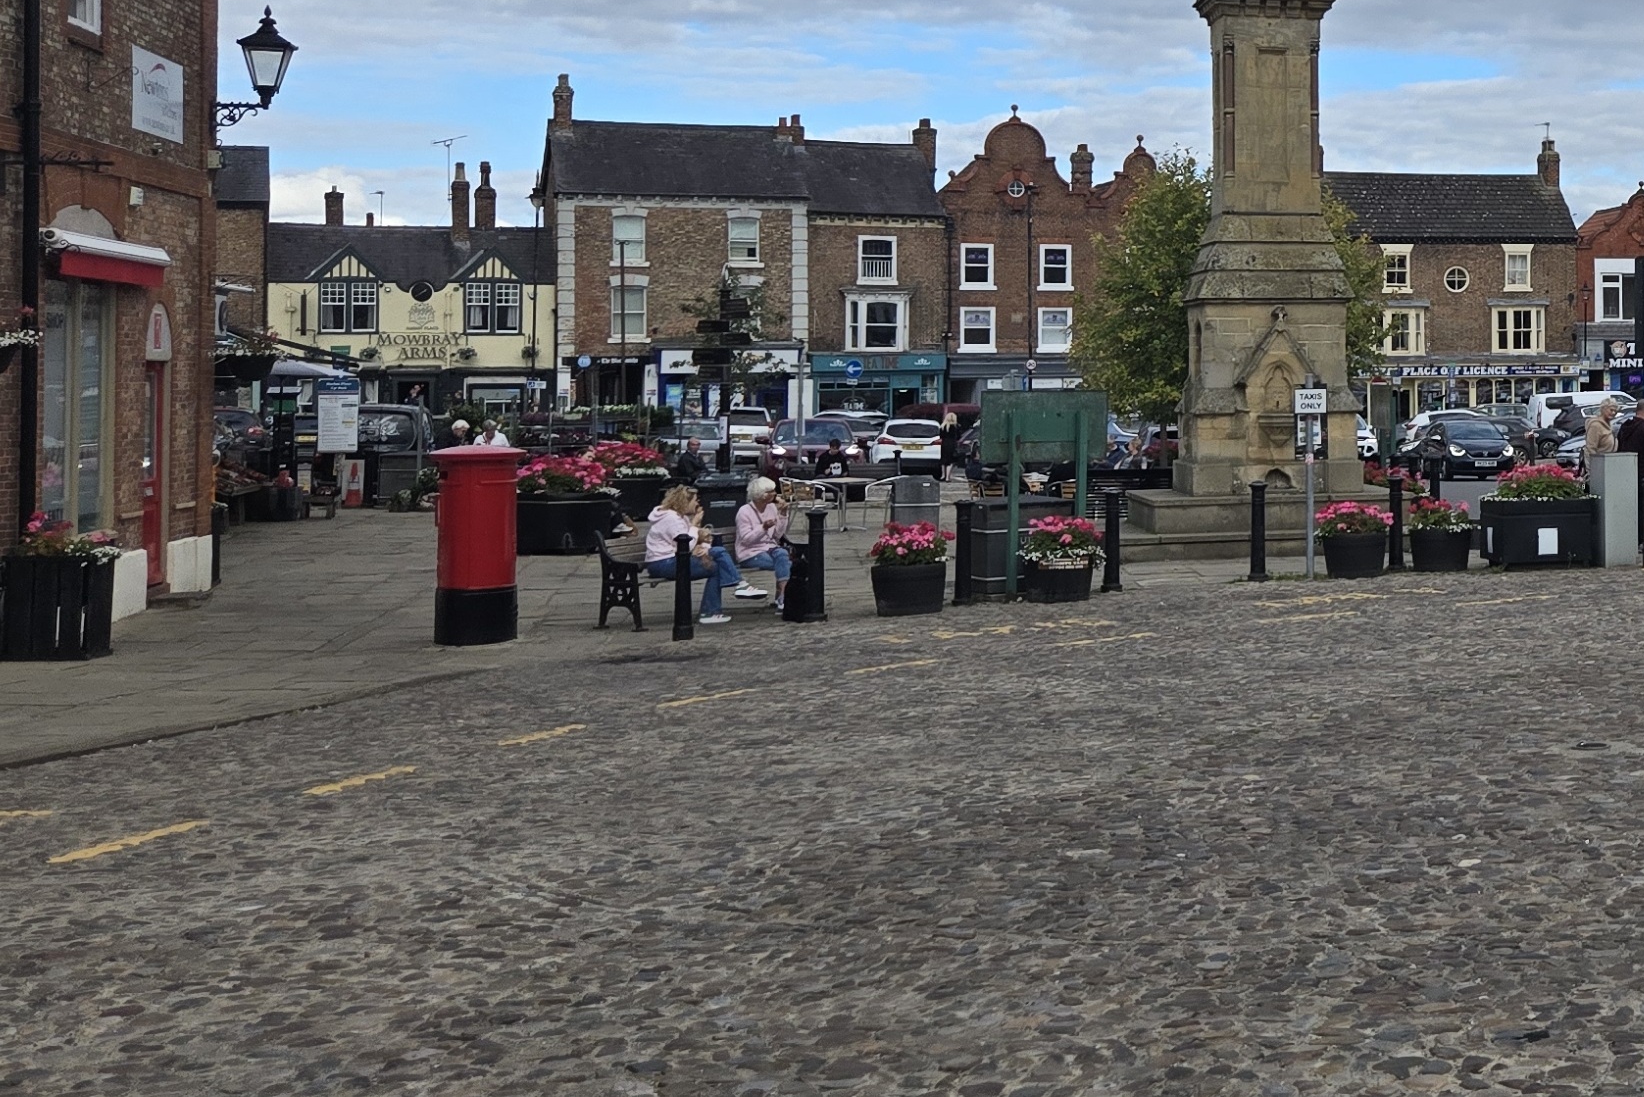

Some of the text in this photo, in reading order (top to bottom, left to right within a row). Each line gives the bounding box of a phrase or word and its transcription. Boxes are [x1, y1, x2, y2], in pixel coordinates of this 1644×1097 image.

[377, 334, 461, 346] MOWBRAY
[398, 346, 447, 360] ARMS
[1609, 358, 1644, 368] MINI
[1402, 366, 1438, 376] PLACE
[1440, 366, 1461, 375] OF
[1463, 366, 1508, 375] LICENCE
[1299, 392, 1322, 400] TAXIS
